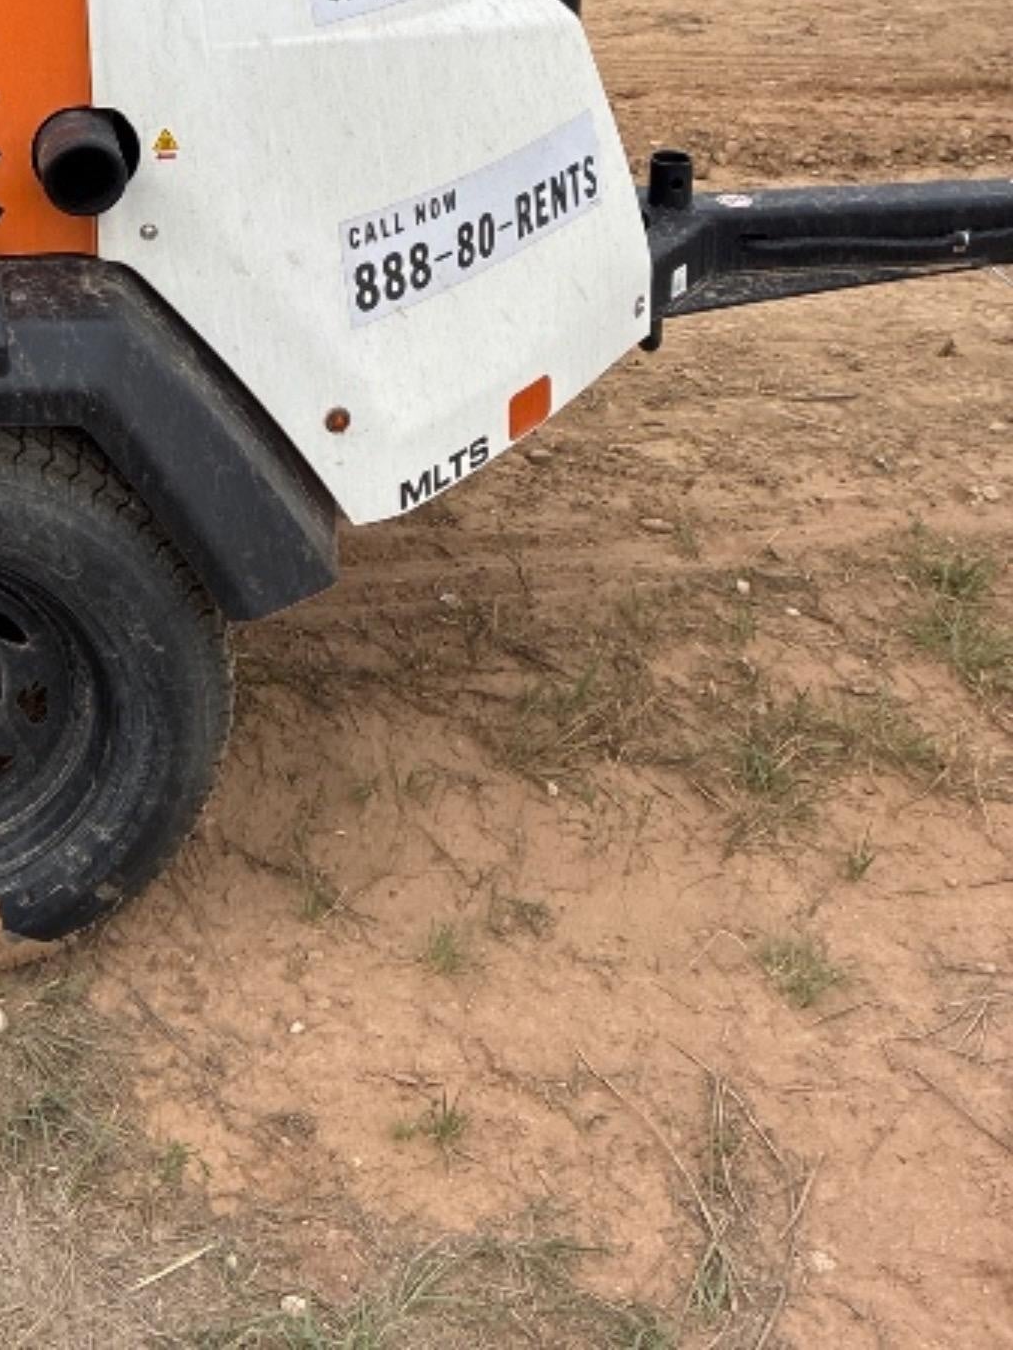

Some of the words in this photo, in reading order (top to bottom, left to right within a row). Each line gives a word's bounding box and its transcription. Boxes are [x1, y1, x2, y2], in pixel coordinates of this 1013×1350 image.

[349, 212, 405, 250] CALL
[415, 188, 457, 226] NOW
[355, 155, 598, 312] 888-80-RENTS
[399, 436, 489, 510] MLTS
